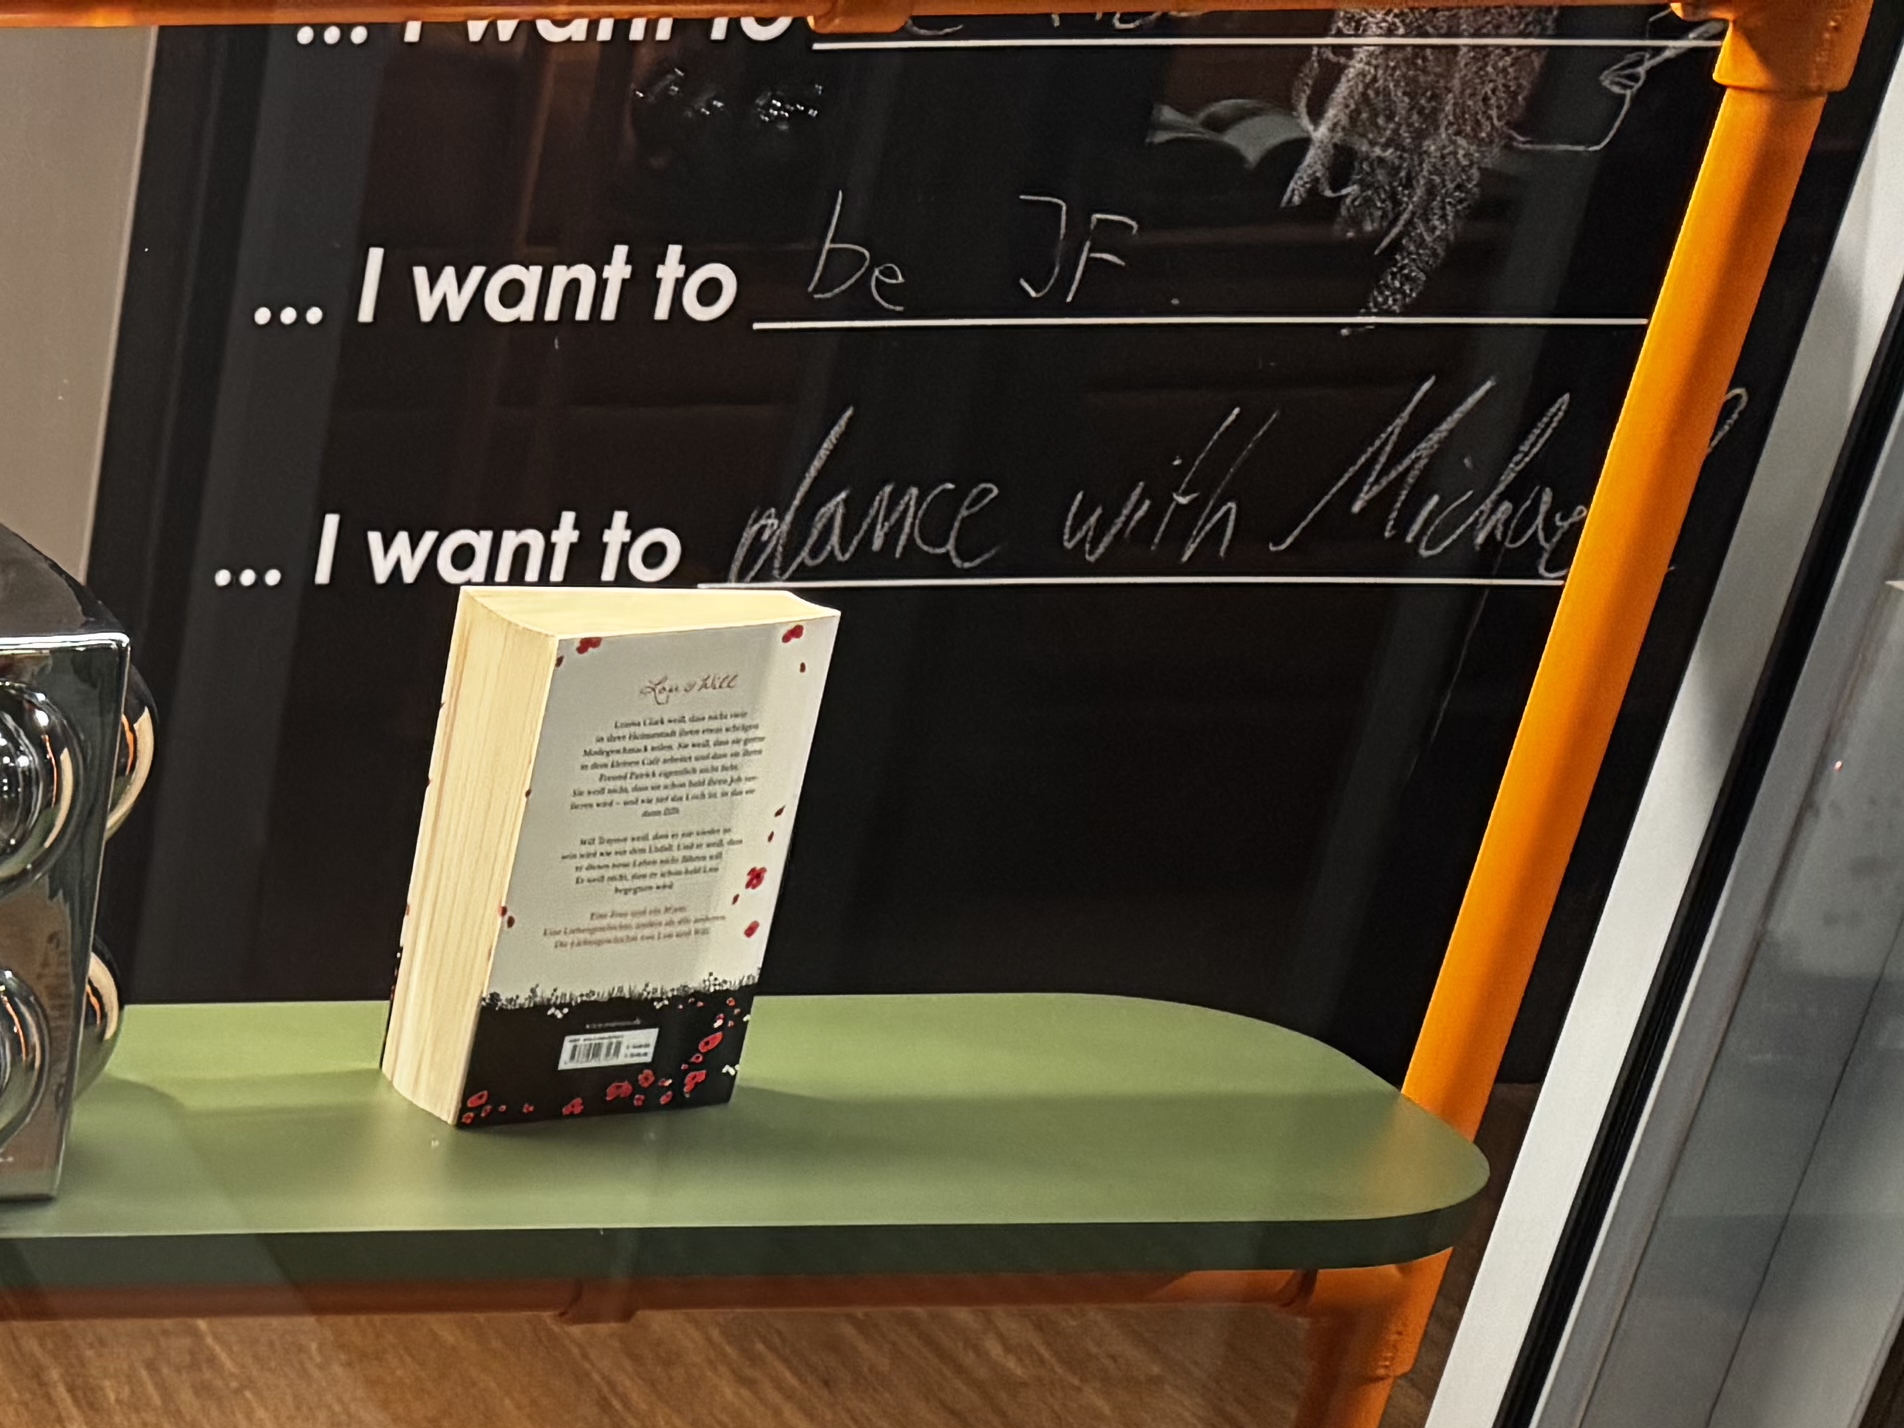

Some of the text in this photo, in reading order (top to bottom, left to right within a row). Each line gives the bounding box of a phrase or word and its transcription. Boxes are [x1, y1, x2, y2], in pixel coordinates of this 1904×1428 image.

[356, 247, 385, 324] I
[409, 246, 638, 325] want
[654, 243, 740, 325] to
[809, 194, 906, 313] be
[729, 405, 1004, 583] dance
[1062, 406, 1281, 564] with
[313, 513, 341, 585] I
[367, 510, 578, 585] want
[600, 510, 681, 583] to
